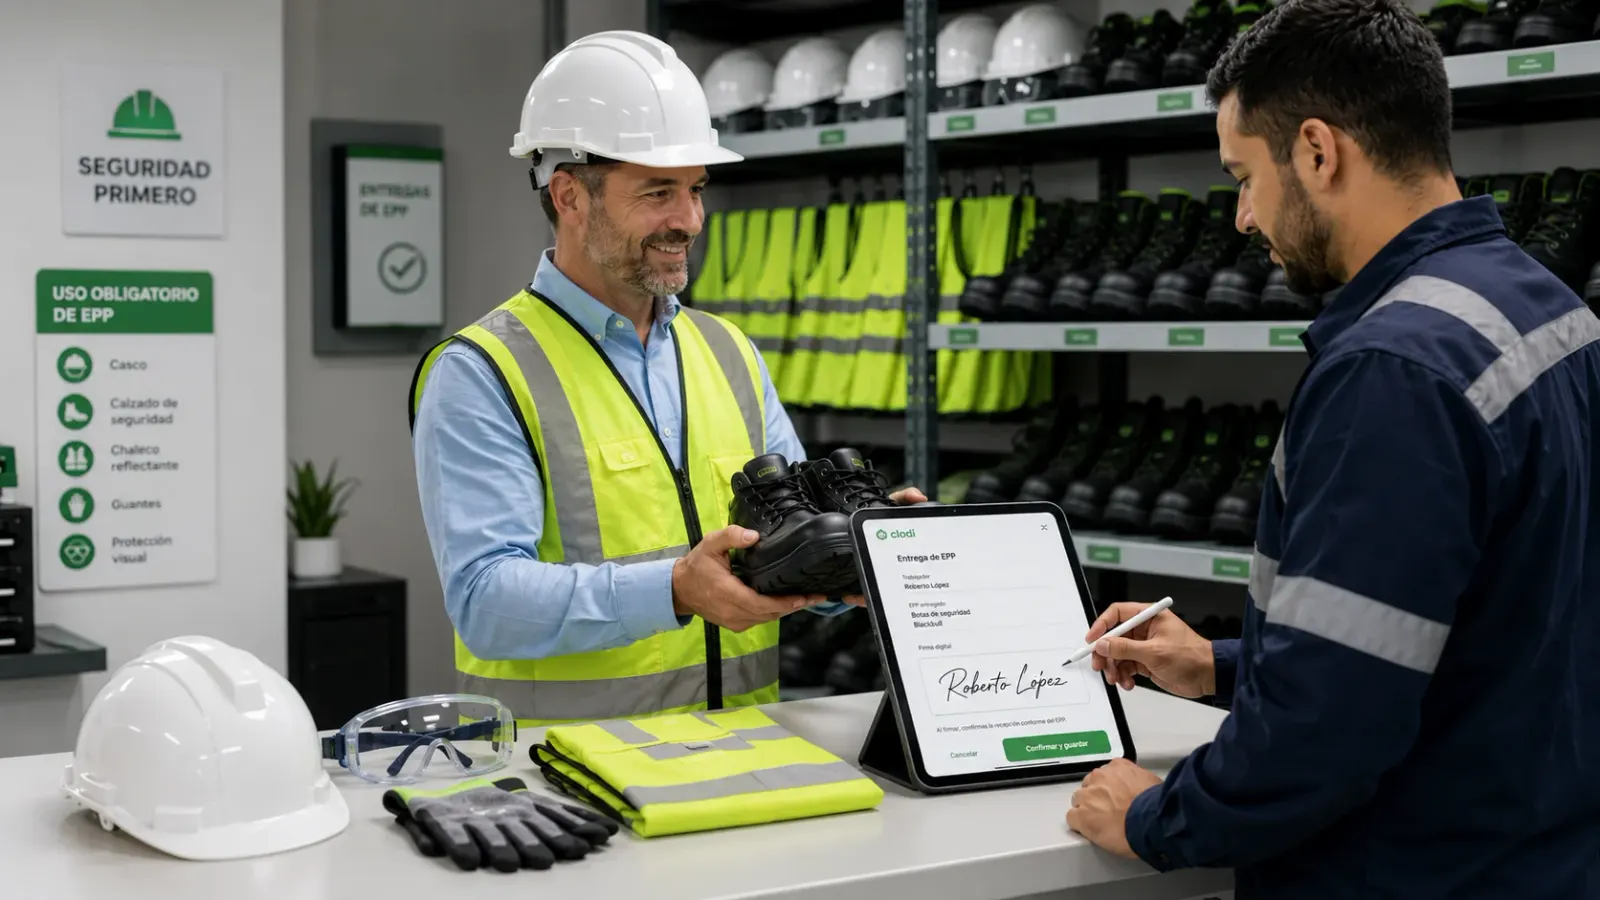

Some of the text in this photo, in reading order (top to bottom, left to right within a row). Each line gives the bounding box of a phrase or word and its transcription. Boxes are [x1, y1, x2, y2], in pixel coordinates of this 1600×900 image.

[78, 157, 211, 180] SEGURIDAD
[95, 185, 196, 206] PRIMERO
[359, 183, 431, 199] ENTREGAS
[360, 203, 409, 218] DE EPP
[53, 286, 200, 303] USO OBLIGATORIO
[53, 307, 114, 322] DE EPP
[109, 359, 147, 371] Casco
[110, 397, 178, 409] Calzado de
[110, 412, 174, 427] seguridad
[111, 443, 160, 455] Chaleco
[111, 459, 179, 471] reflectante
[112, 498, 161, 510] Guantes
[890, 529, 915, 538] clodi
[112, 534, 172, 548] Protección
[112, 552, 147, 564] visual
[897, 552, 956, 563] Entrega de EPP
[930, 582, 950, 590] López
[940, 608, 971, 618] seguridad
[939, 664, 1068, 702] Roberto López
[1026, 742, 1058, 752] Confirmar
[1064, 740, 1088, 750] guardar
[950, 750, 978, 759] Cancelar
